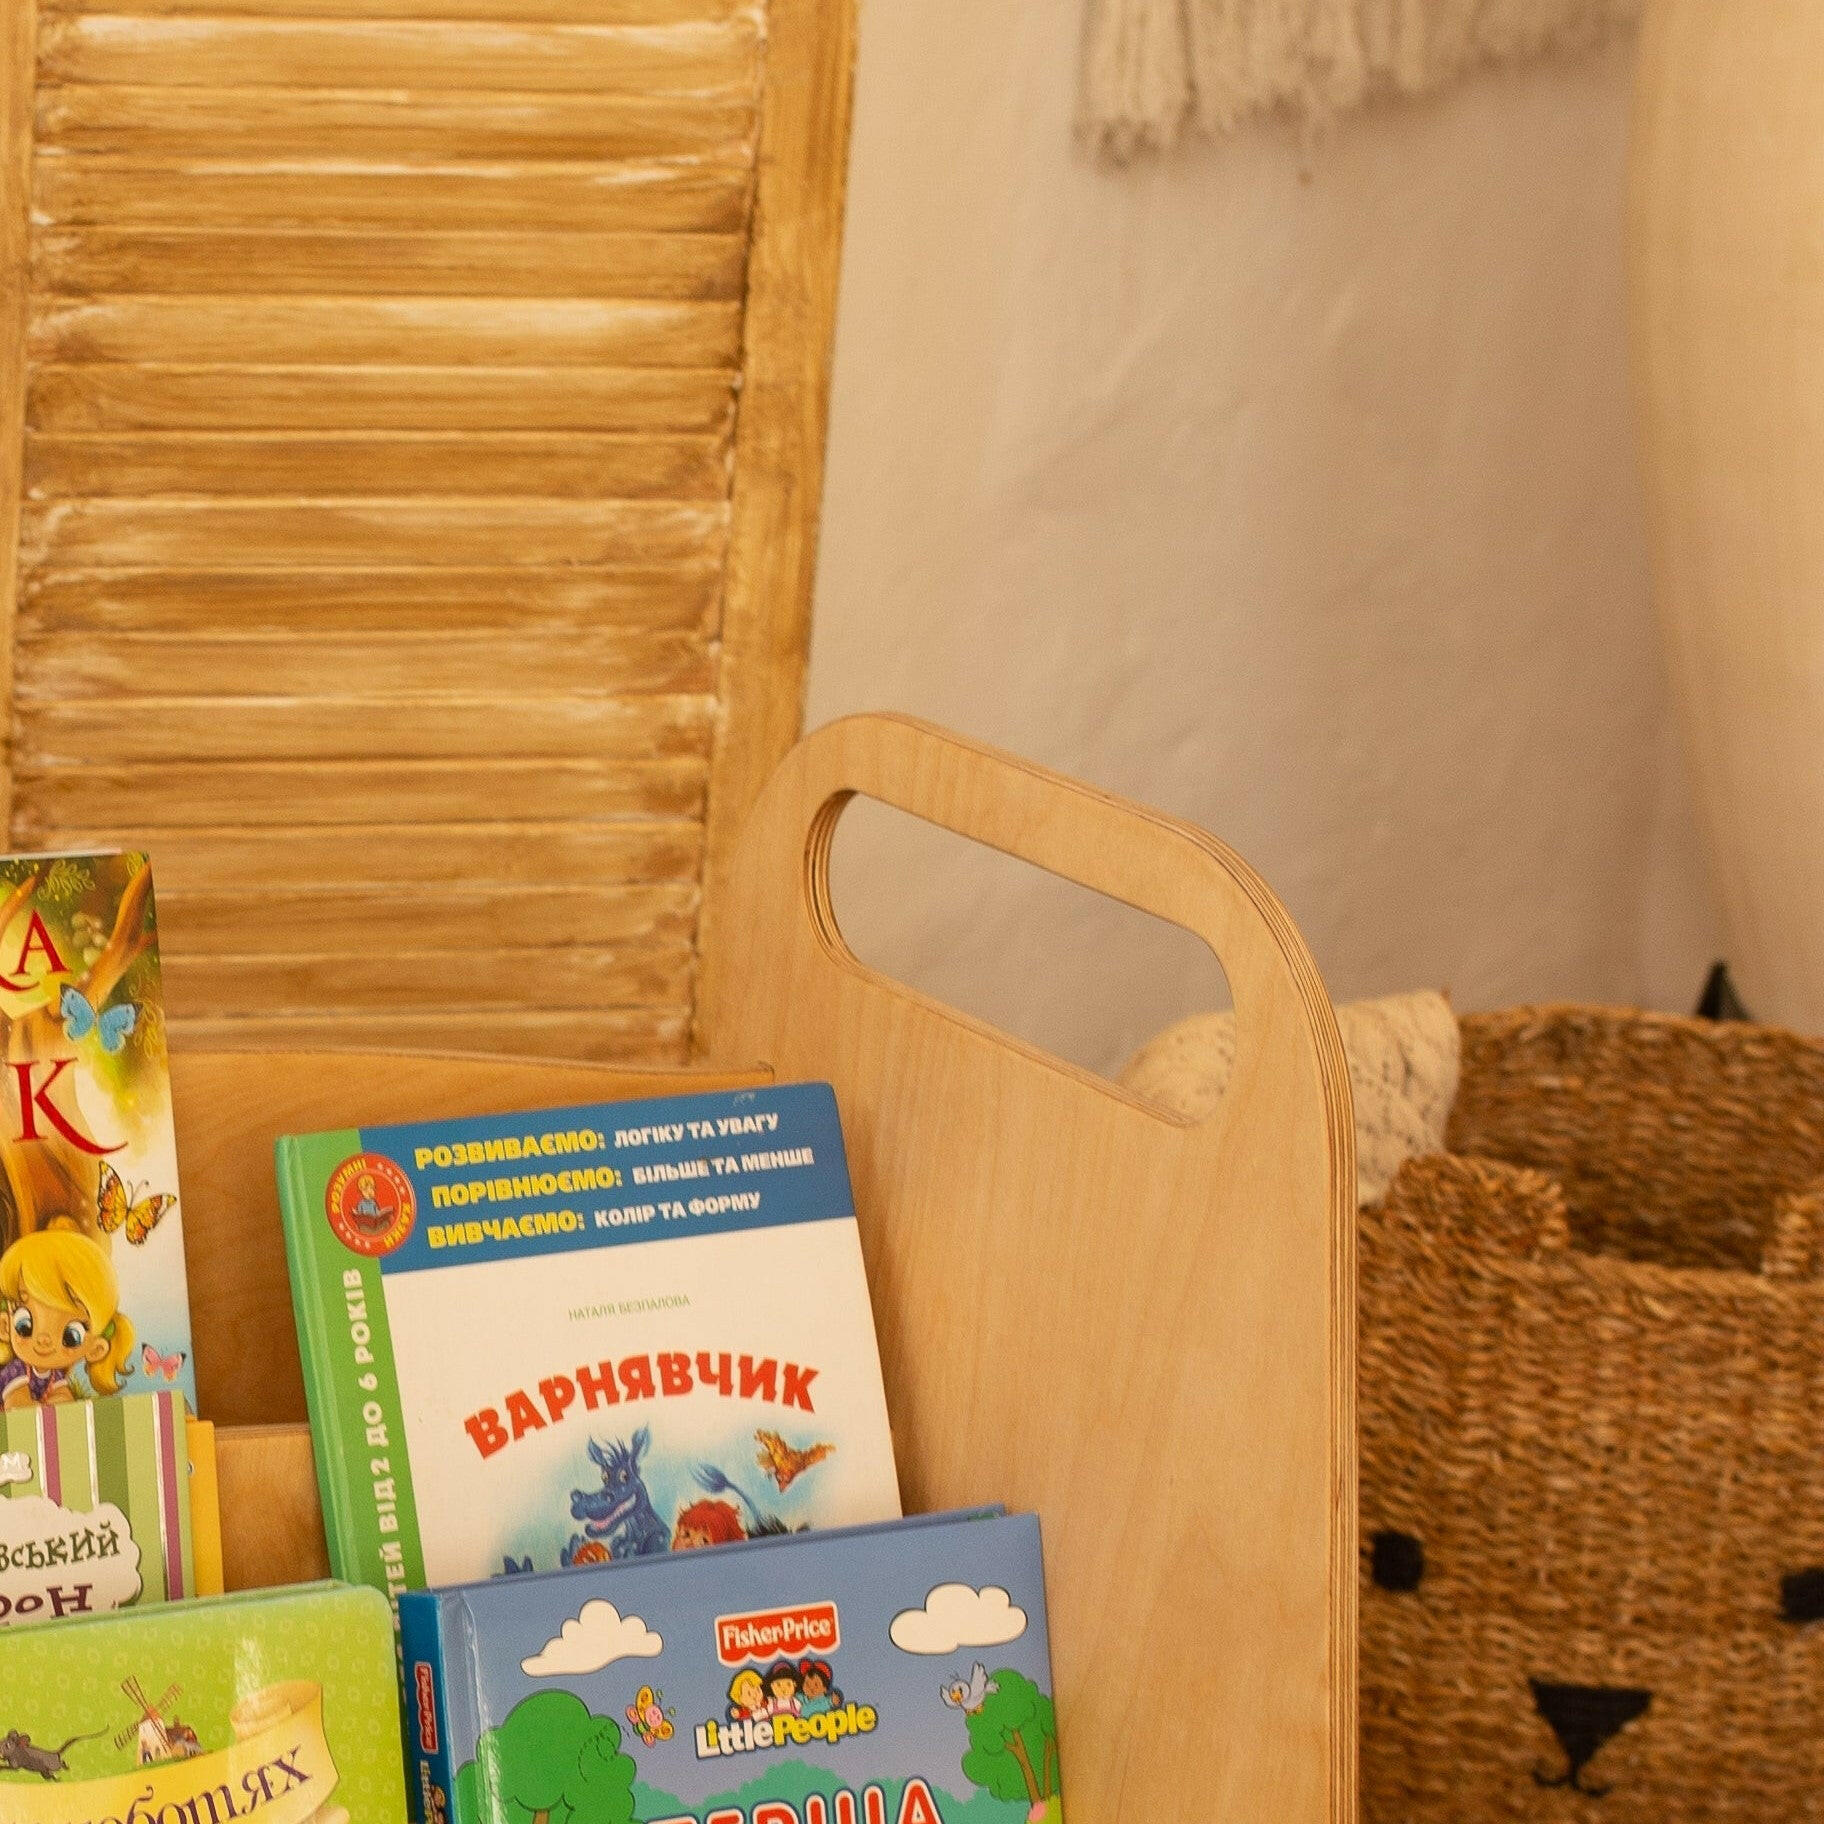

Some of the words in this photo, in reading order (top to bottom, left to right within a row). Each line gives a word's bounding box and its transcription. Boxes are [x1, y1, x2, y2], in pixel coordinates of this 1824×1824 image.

[414, 1128, 606, 1170] РОЗВИВАЄМО:
[614, 1122, 684, 1148] ЛОГІКУ
[686, 1120, 716, 1140] ТА
[716, 1112, 779, 1136] УВАГУ
[431, 1166, 624, 1208] ПОРІВНЮЄМО:
[632, 1158, 710, 1185] БІЛЬШЕ
[710, 1156, 740, 1175] ТА
[741, 1147, 815, 1172] МЕНШЕ
[427, 1210, 586, 1249] ВИВЧАЄМО:
[594, 1204, 656, 1229] КОЛІР
[658, 1202, 687, 1220] ТА
[687, 1191, 761, 1217] ФОРМУ
[342, 1268, 375, 1366] РОКІВ
[358, 1372, 378, 1392] 6
[463, 1351, 820, 1460] ВАРНЯВЧИК
[363, 1401, 389, 1448] ДО
[370, 1457, 391, 1476] 2
[373, 1478, 399, 1534] ВІД
